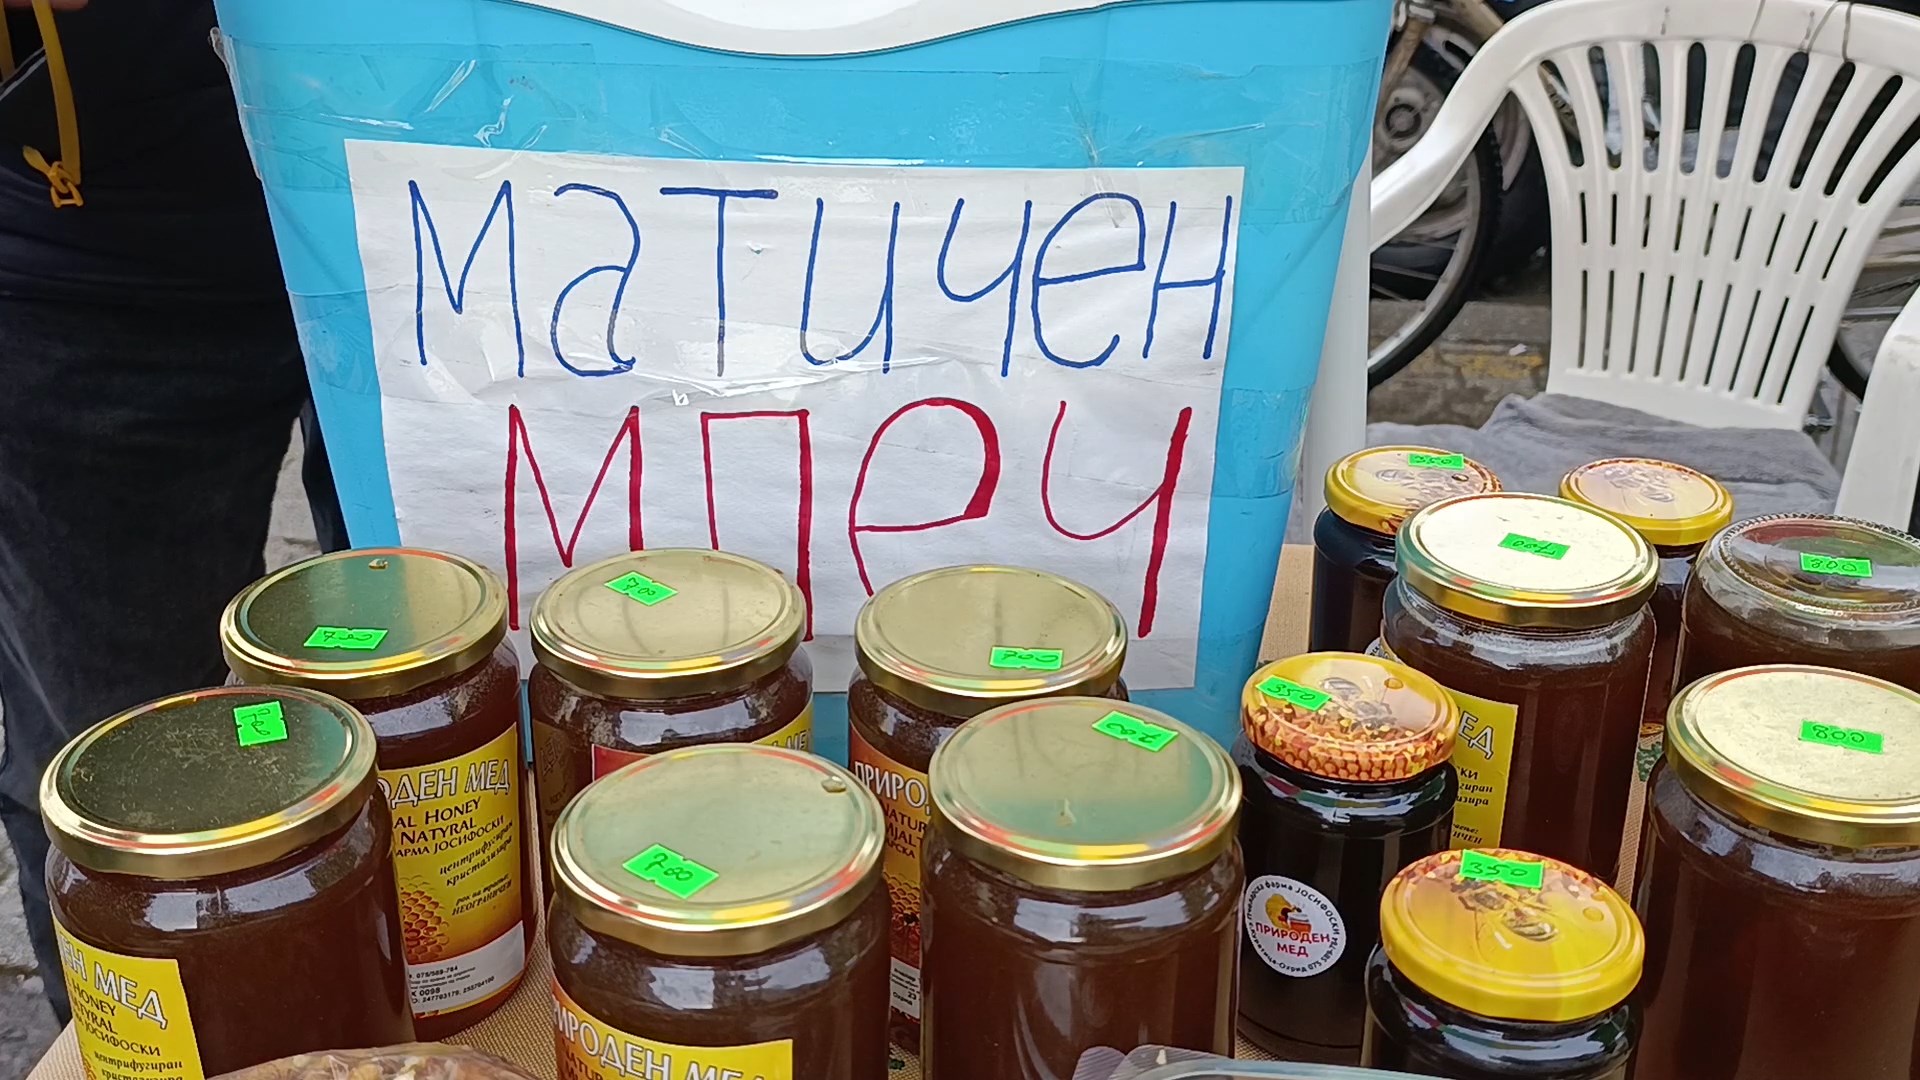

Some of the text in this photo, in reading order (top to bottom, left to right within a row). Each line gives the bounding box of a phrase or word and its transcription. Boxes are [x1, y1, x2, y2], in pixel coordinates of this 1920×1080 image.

[1513, 540, 1556, 556] 700
[622, 577, 657, 597] 700
[1001, 650, 1059, 663] 700
[1267, 684, 1316, 701] 350
[1457, 706, 1493, 760] ЕД
[1812, 725, 1865, 743] 800
[464, 759, 510, 795] МЕД
[854, 761, 931, 815] ПРИРО
[425, 796, 481, 824] HONEY
[400, 817, 477, 845] NATYRAL
[645, 852, 695, 882] 700
[1464, 862, 1528, 877] 350
[1255, 922, 1330, 944] ПРИРОДЕН
[1277, 943, 1309, 957] МЕД
[94, 961, 168, 1030] МЕД
